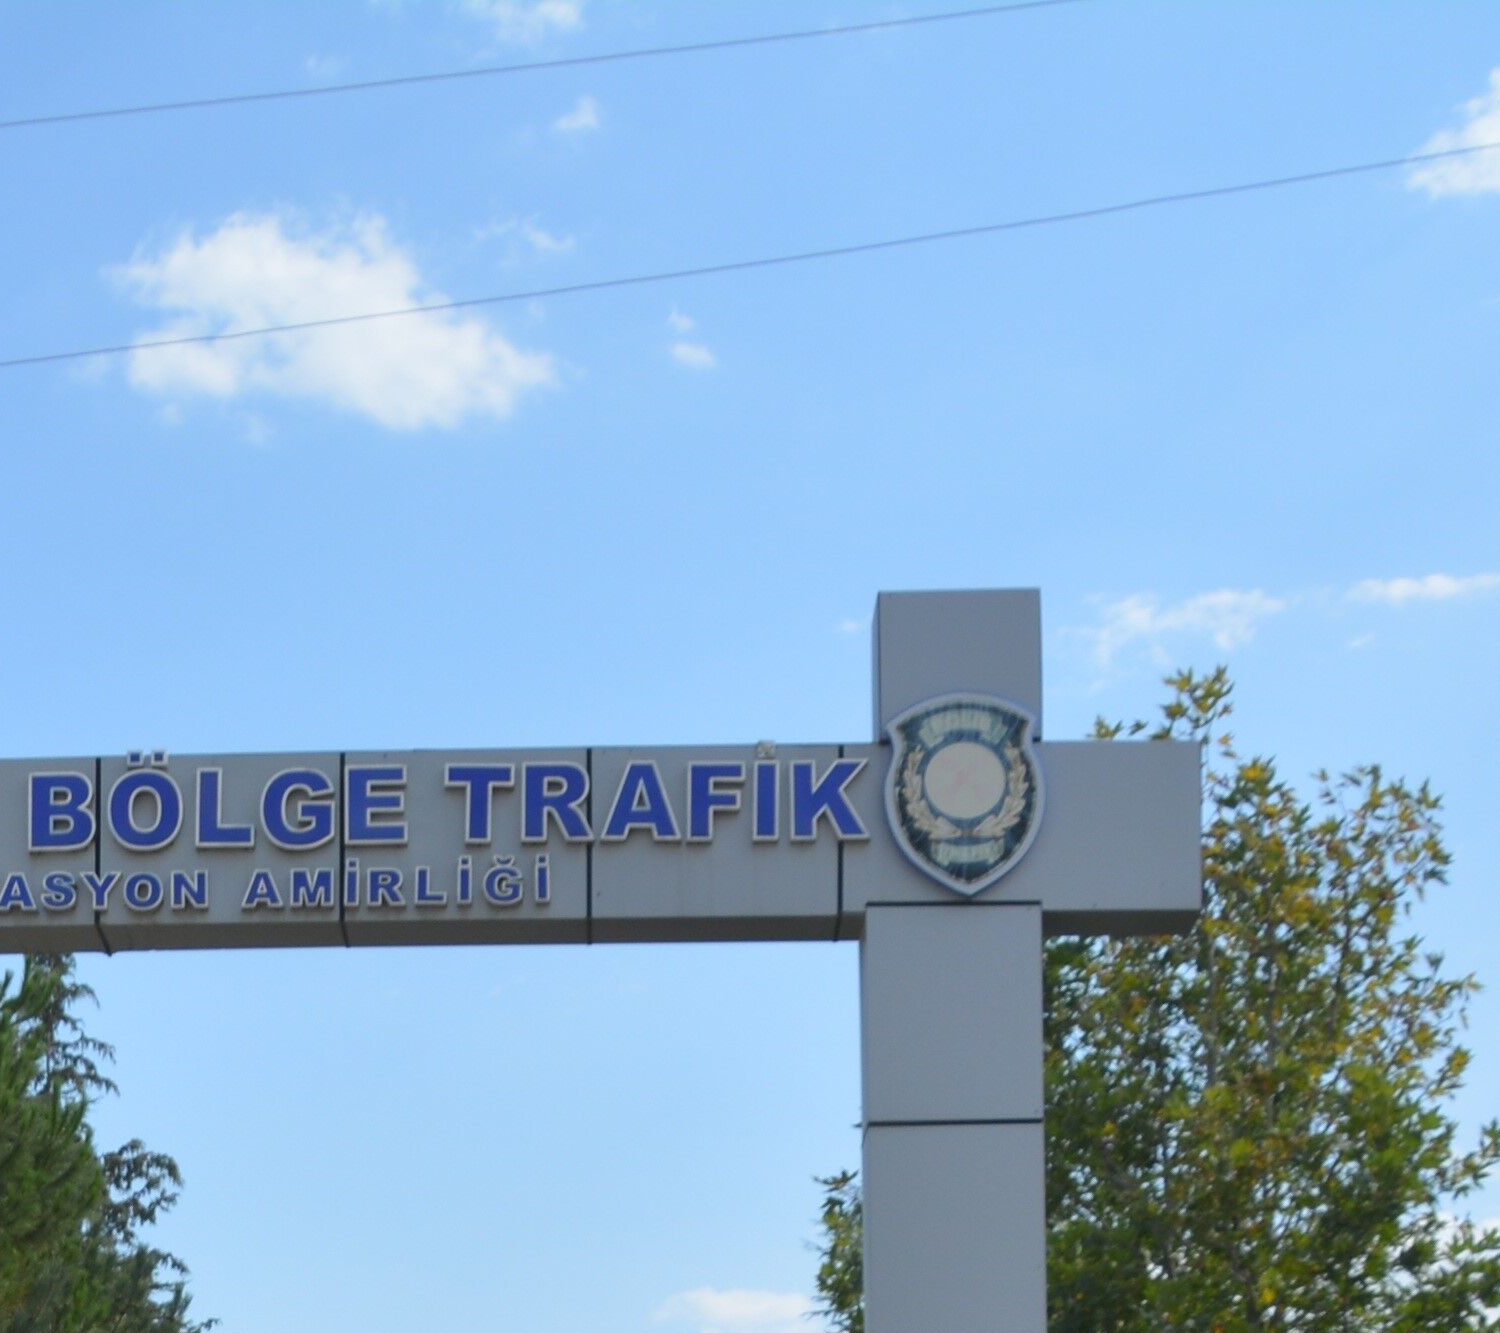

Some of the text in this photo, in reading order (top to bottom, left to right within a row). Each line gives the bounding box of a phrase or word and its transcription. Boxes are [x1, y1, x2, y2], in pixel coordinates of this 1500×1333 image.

[27, 750, 409, 852] BÖLGE
[444, 741, 872, 845] TRAFİK
[242, 854, 552, 908] AMİRLİĞİ
